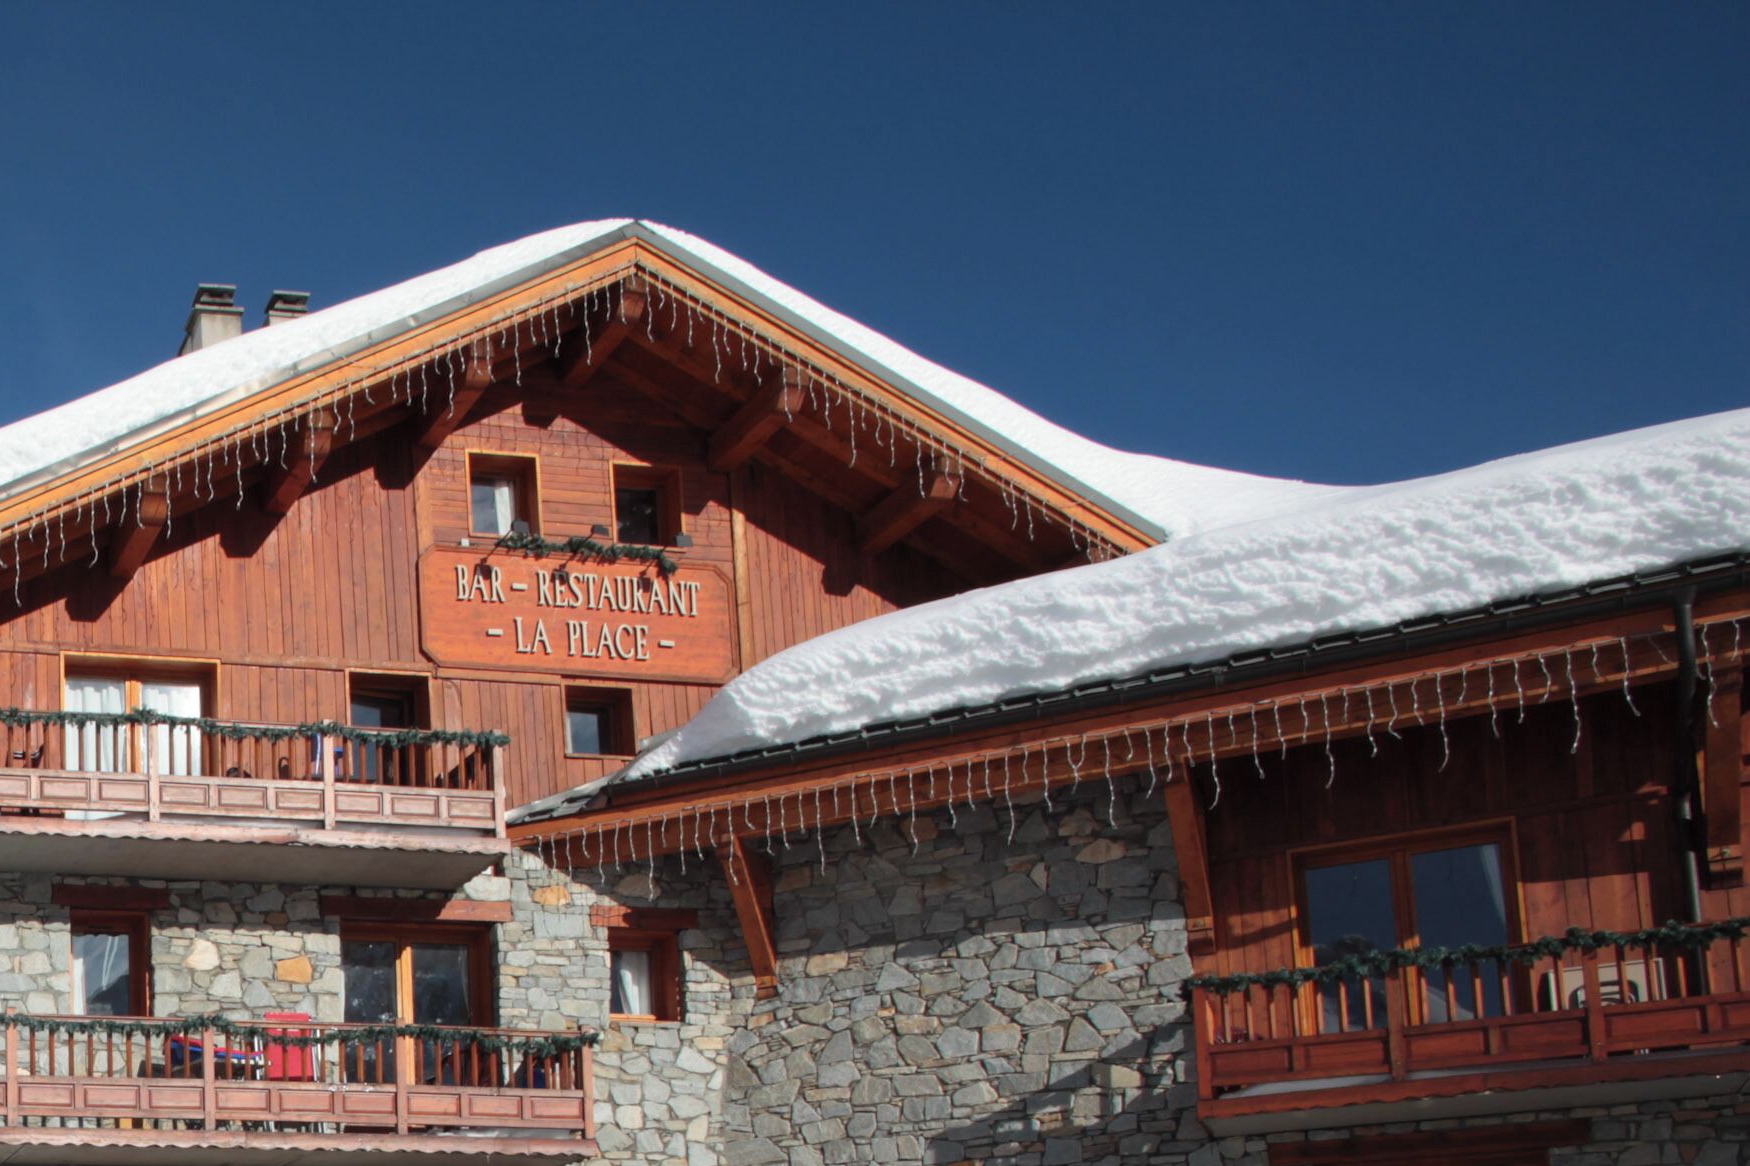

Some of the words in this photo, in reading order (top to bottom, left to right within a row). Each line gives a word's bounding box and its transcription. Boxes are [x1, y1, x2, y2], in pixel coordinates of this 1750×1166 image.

[455, 563, 506, 604] BAR
[536, 569, 701, 618] RESTAURANT
[514, 616, 552, 655] LA
[566, 619, 651, 661] PLACE
